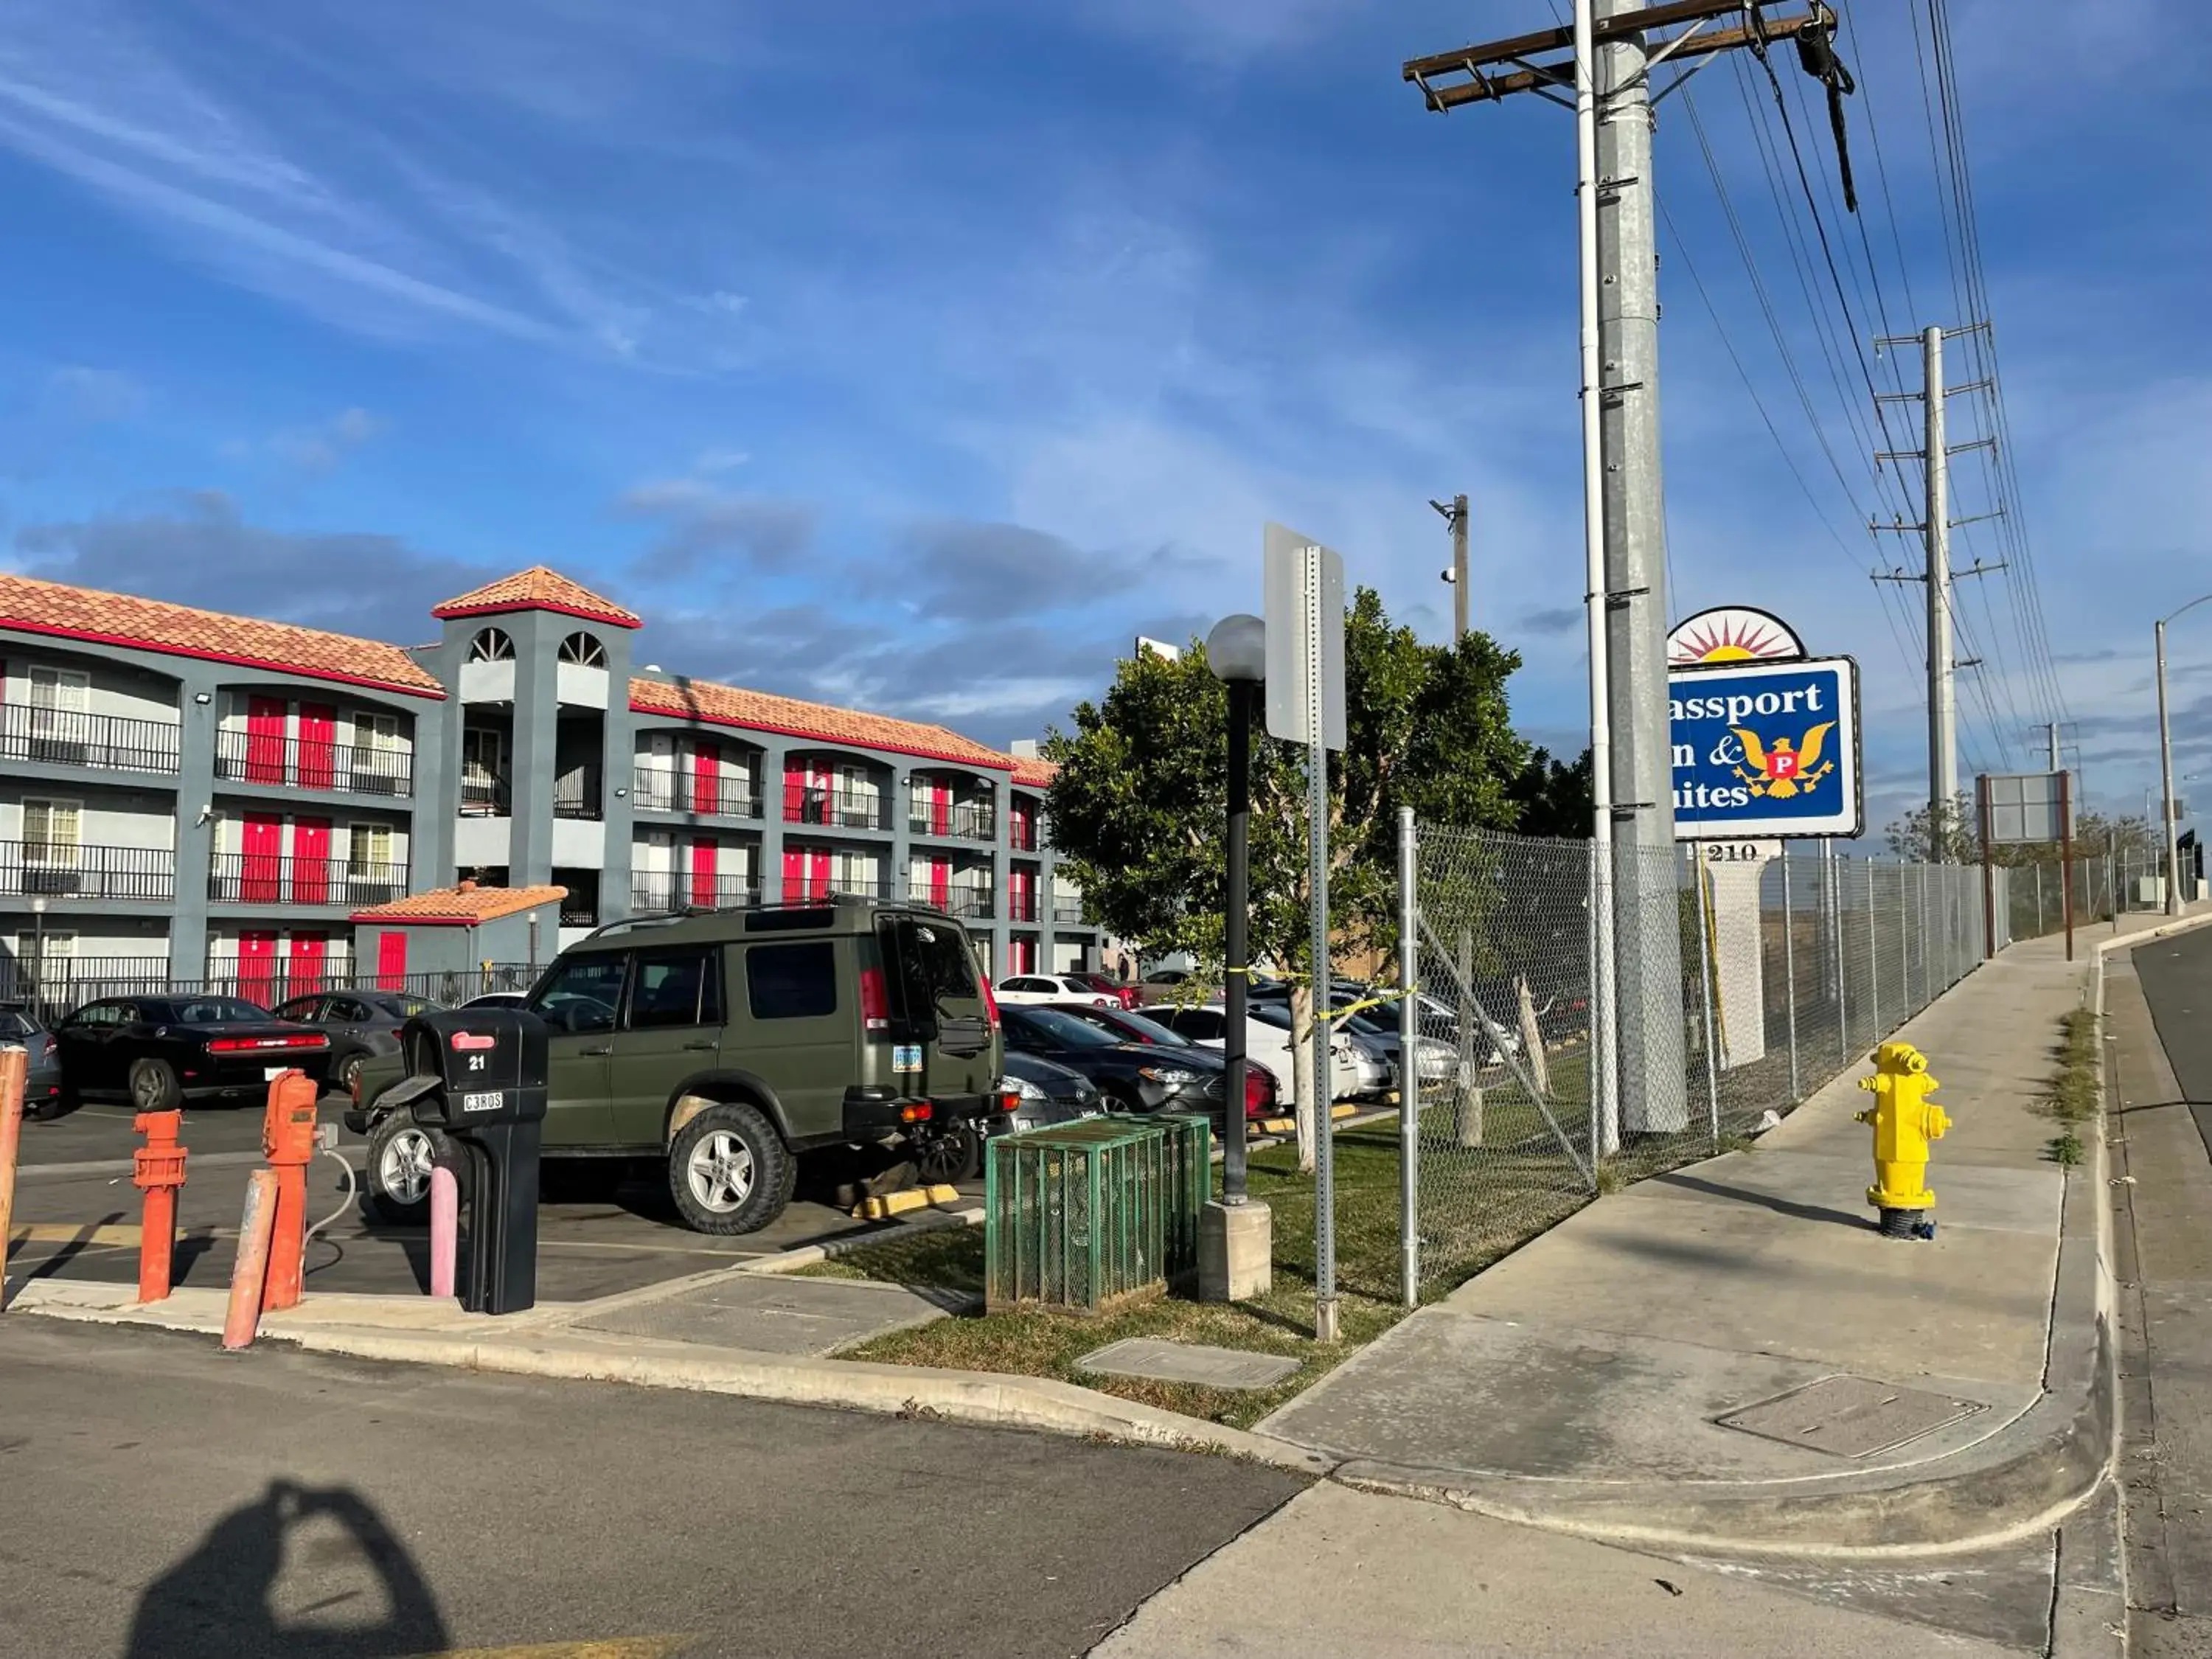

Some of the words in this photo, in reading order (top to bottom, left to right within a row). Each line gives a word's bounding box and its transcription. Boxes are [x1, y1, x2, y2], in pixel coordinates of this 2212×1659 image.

[1669, 683, 1823, 726] assport
[1710, 735, 1746, 765] &
[1775, 756, 1793, 773] P
[1708, 844, 1757, 862] 210
[469, 1055, 484, 1071] 21
